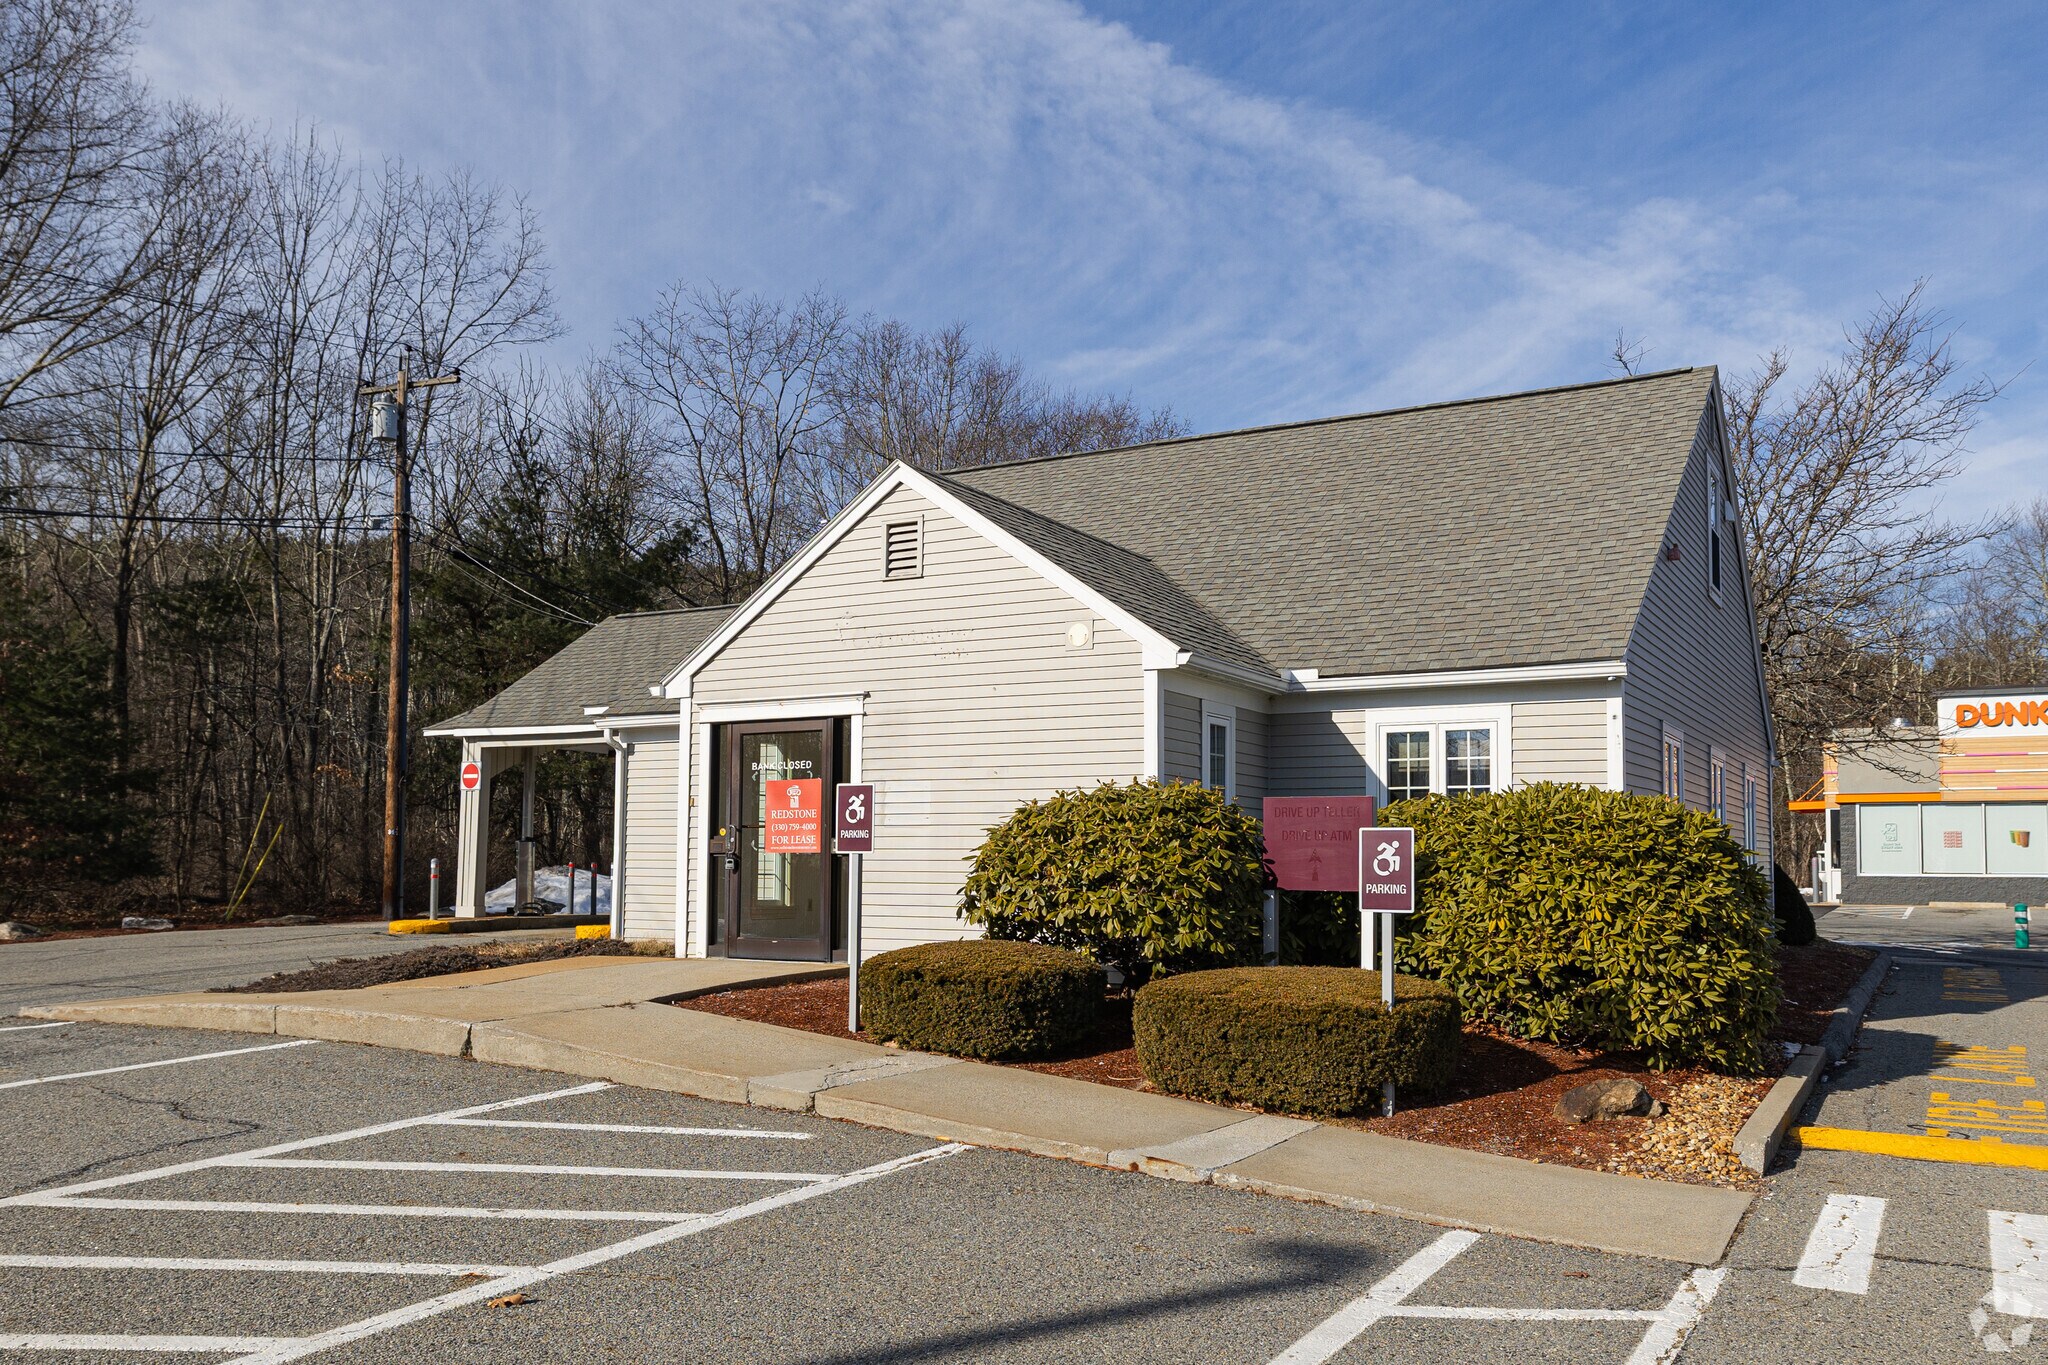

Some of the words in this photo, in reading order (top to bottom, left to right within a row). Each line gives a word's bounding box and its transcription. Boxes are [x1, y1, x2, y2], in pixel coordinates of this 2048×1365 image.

[1956, 700, 2048, 728] DUNK
[752, 762, 774, 770] BANK
[780, 761, 812, 769] CLOSED
[771, 809, 817, 819] REDSTONE
[1274, 807, 1303, 818] DRIVE
[1306, 807, 1319, 817] UP
[1323, 806, 1360, 818] TELLER
[771, 835, 789, 844] FOR
[791, 835, 817, 844] LEASE
[840, 830, 869, 839] PARKING
[1281, 831, 1309, 841] DRIVE
[1314, 831, 1328, 841] UP
[1331, 831, 1352, 841] ATM
[1366, 884, 1407, 894] PARKING
